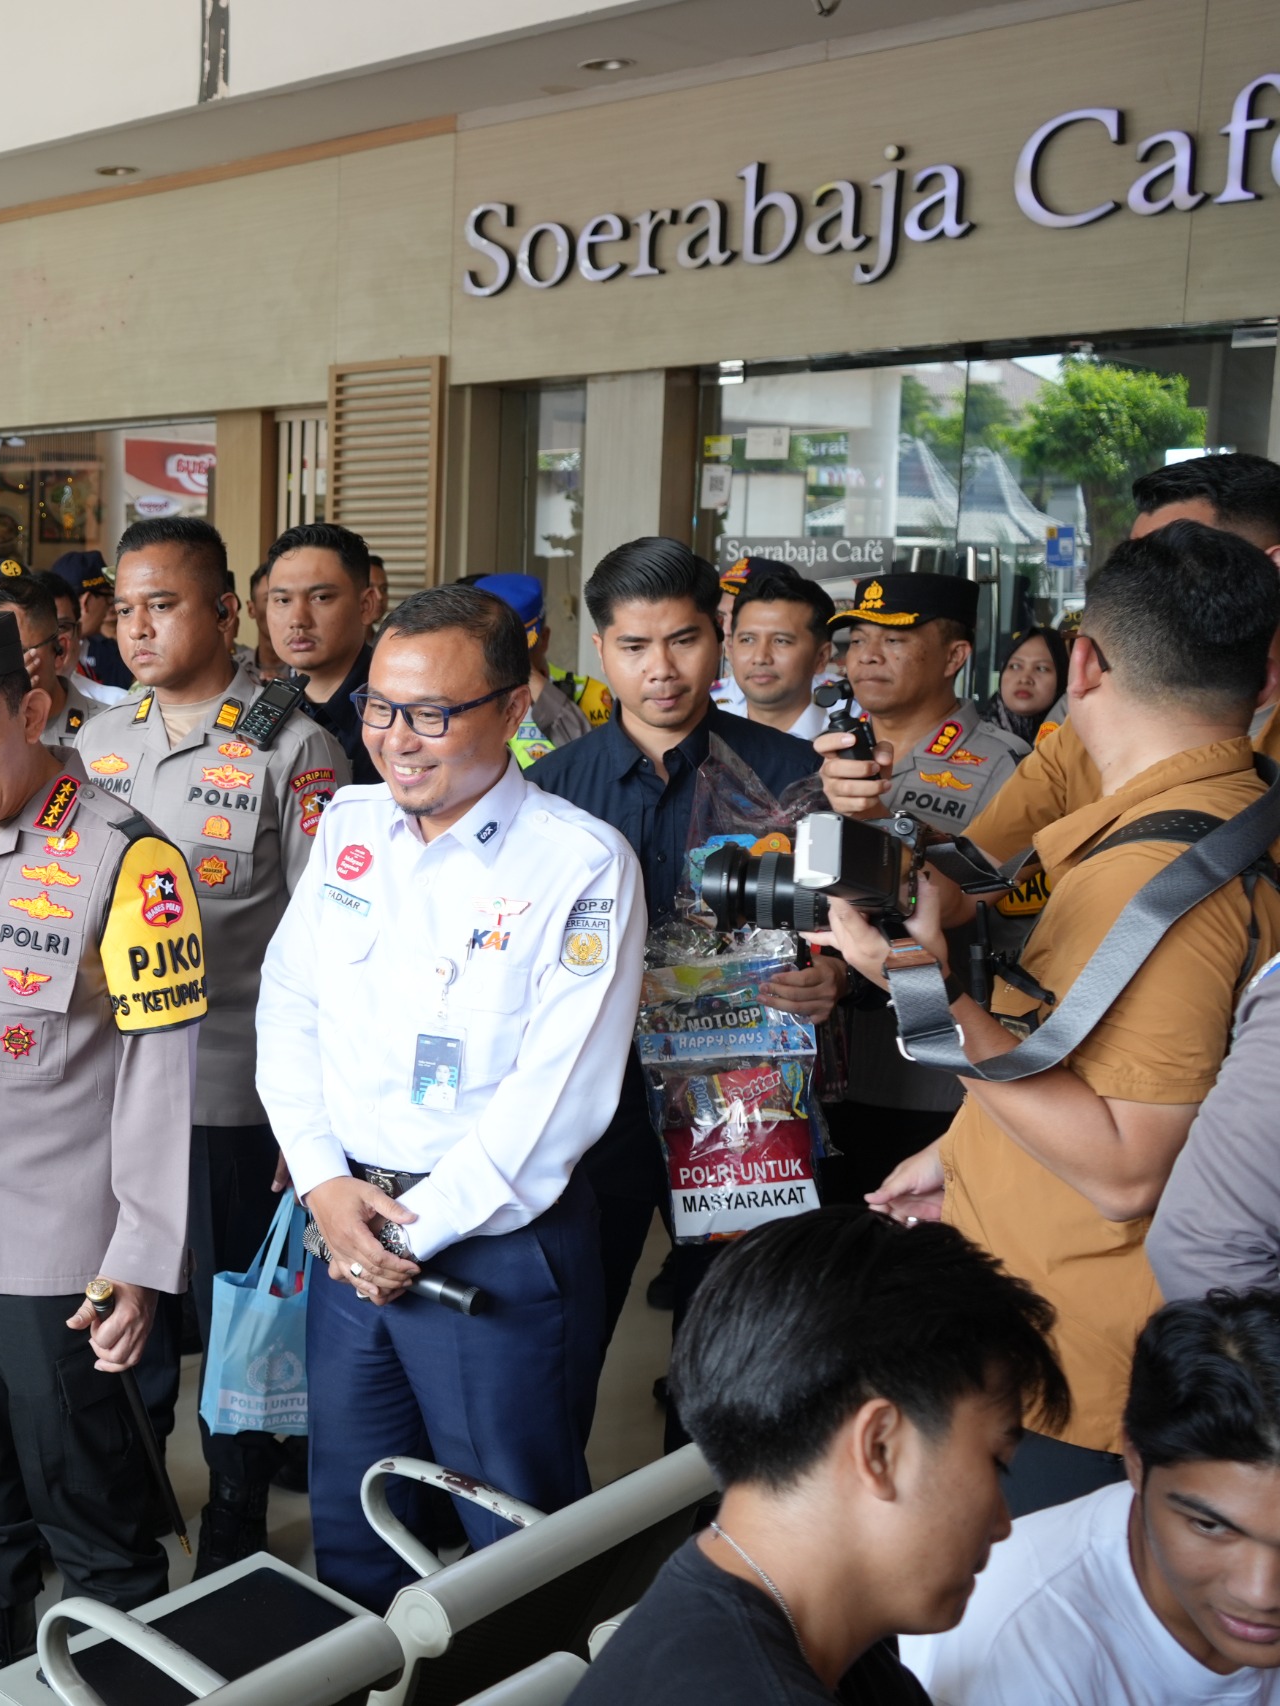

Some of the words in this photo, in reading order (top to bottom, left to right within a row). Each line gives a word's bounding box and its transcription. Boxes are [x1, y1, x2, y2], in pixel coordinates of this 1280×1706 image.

[462, 144, 977, 298] Soerabaja
[1014, 73, 1280, 230] Caf
[726, 539, 829, 567] Soerabaja
[831, 538, 884, 563] Café
[294, 770, 331, 788] SPRIPIM
[187, 786, 258, 812] POLRI
[901, 790, 966, 820] POLRI
[145, 903, 165, 921] MABES
[600, 901, 608, 911] 8
[565, 919, 590, 929] ERETA
[591, 920, 606, 929] API
[0, 923, 70, 956] POLRI
[471, 928, 511, 951] KAI
[128, 933, 201, 982] PJKO
[686, 1007, 761, 1032] MOTOGP
[679, 1035, 725, 1049] HAPPY
[728, 1031, 764, 1046] DAYS
[730, 1070, 782, 1101] Better
[679, 1164, 735, 1186] POLRI
[740, 1158, 805, 1182] UNTUK
[682, 1186, 807, 1214] MASYARAKAT
[230, 1396, 268, 1411] POLRI
[271, 1397, 307, 1409] UNTU
[228, 1412, 308, 1427] MASYARAKA
